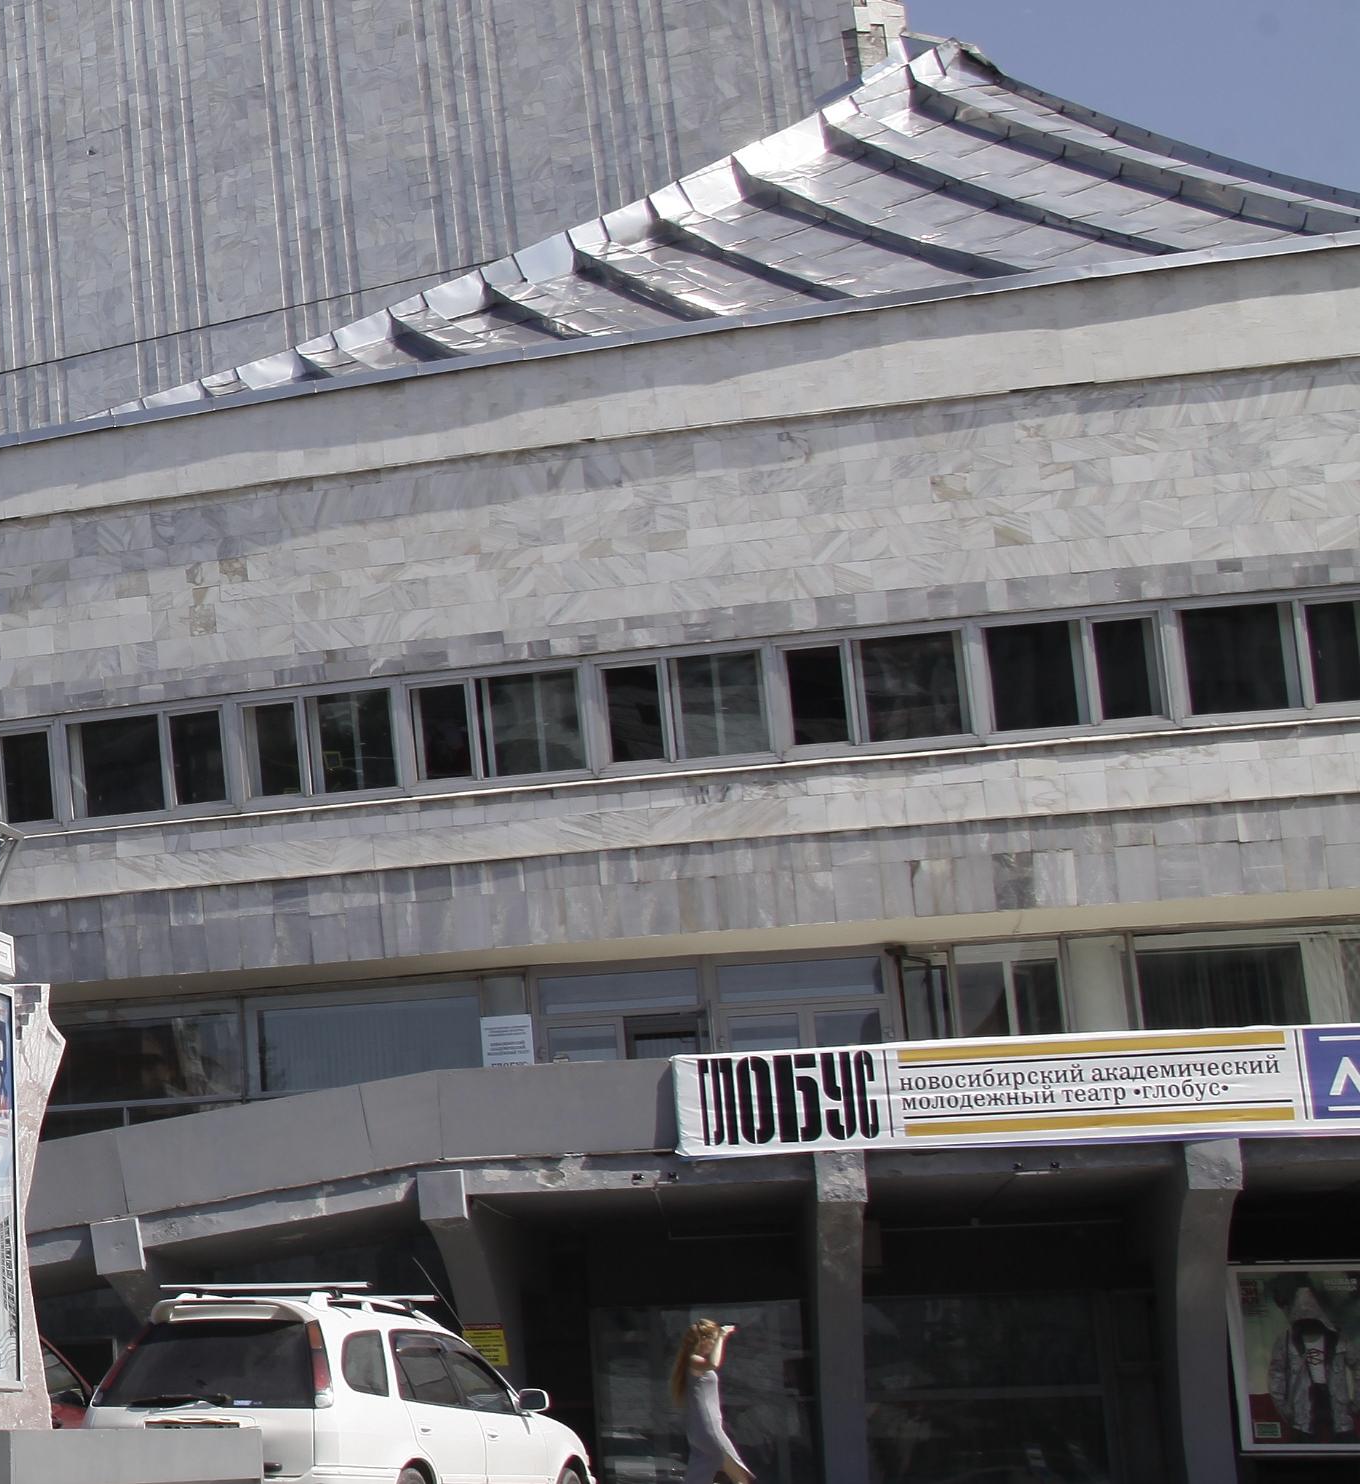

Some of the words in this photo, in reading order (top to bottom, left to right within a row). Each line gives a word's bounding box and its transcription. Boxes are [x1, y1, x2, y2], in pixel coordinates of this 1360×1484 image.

[899, 1064, 1085, 1092] новосибирский
[1091, 1054, 1281, 1084] академический
[698, 1050, 879, 1147] ГЛОБУС
[902, 1086, 1057, 1112] молодежный
[1061, 1084, 1127, 1107] театр
